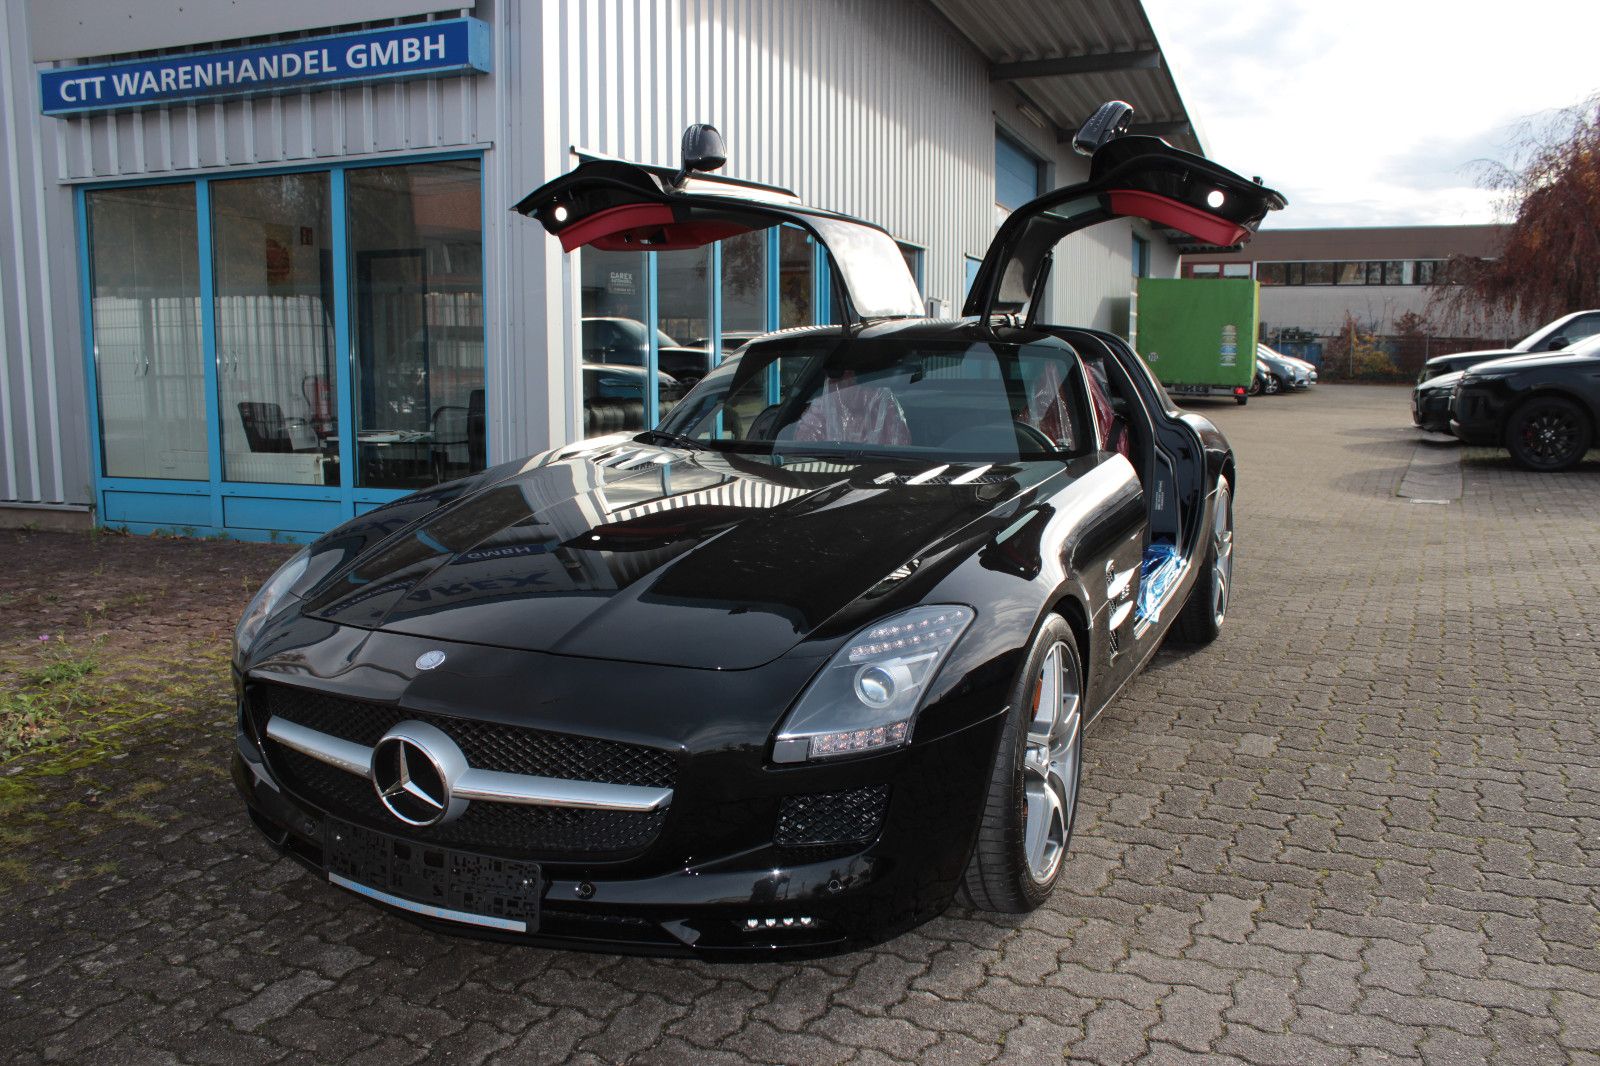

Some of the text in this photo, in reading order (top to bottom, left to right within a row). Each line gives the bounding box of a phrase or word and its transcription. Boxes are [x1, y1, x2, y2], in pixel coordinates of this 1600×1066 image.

[60, 34, 445, 102] CTT WARENHANDEL GMBH
